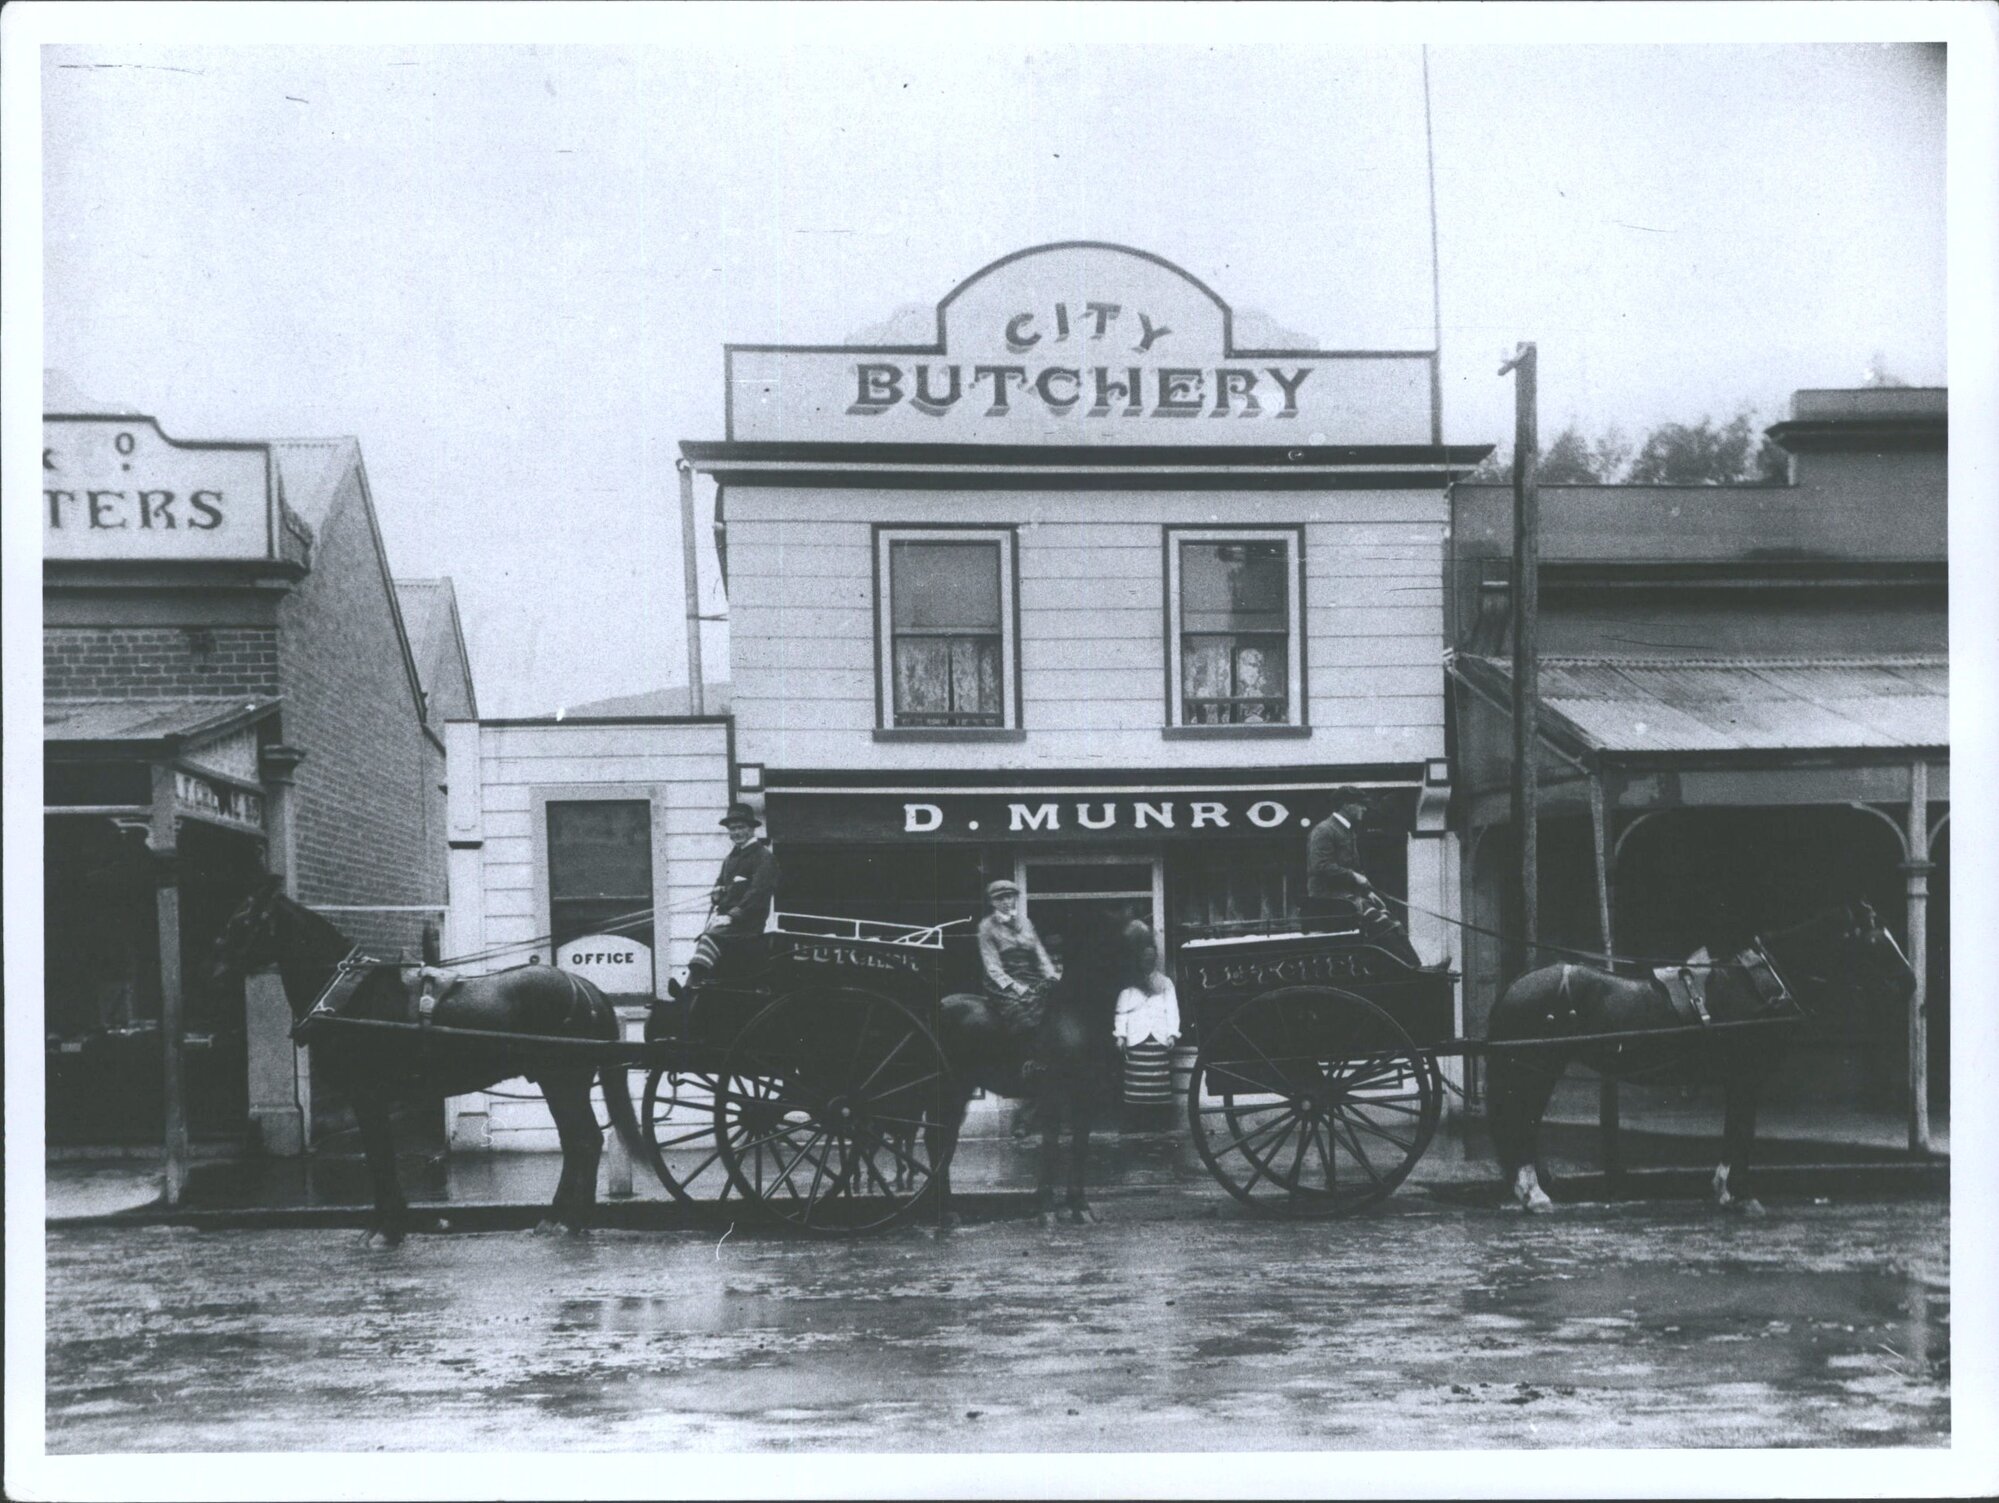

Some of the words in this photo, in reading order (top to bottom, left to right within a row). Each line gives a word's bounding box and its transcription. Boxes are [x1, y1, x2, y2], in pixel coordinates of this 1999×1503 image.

[1005, 302, 1172, 353] CITY
[846, 363, 1313, 417] BUTCHERY
[1008, 801, 1311, 830] MUNRO.
[572, 952, 634, 965] OFFICE
